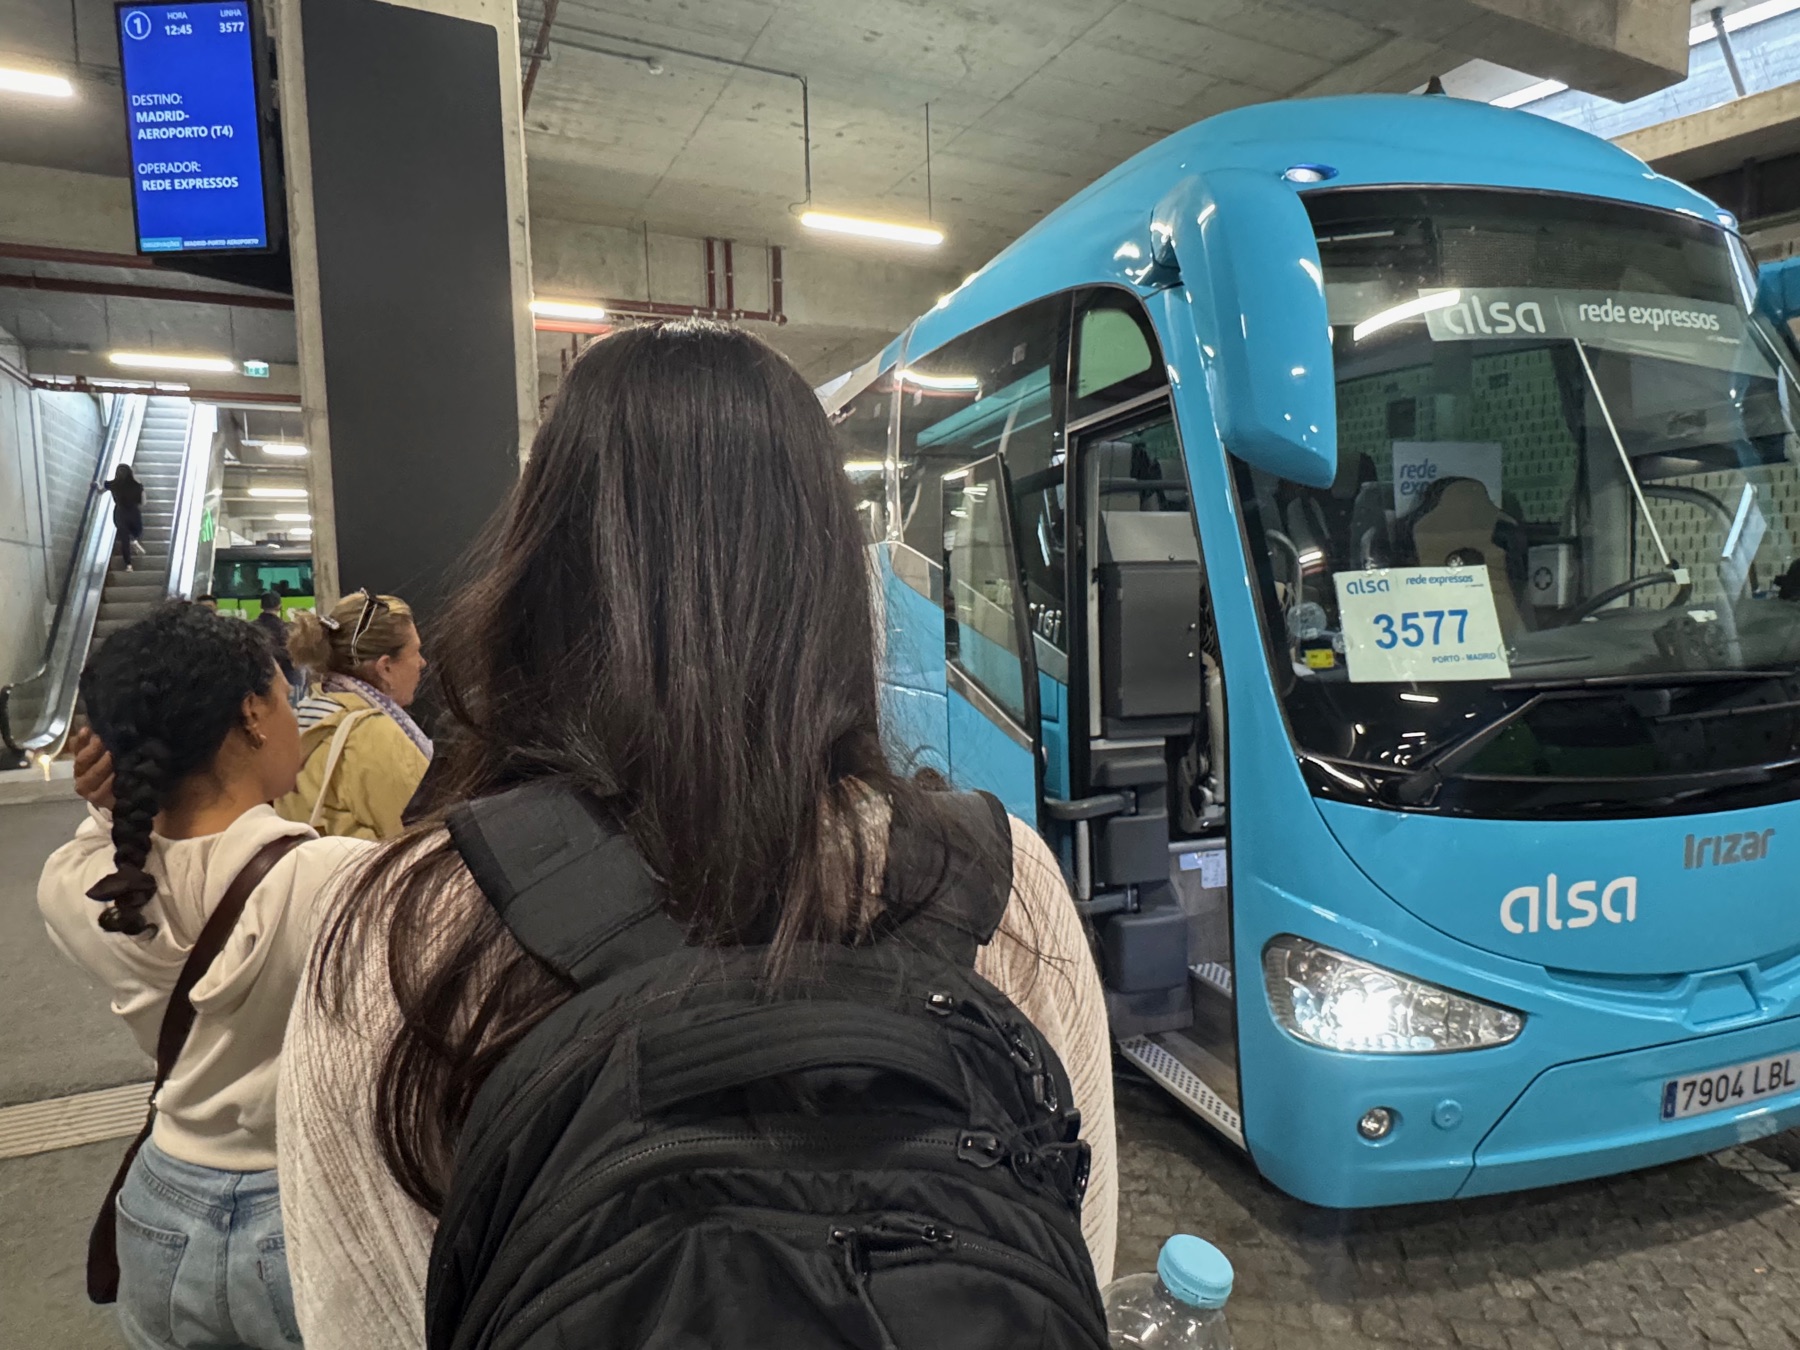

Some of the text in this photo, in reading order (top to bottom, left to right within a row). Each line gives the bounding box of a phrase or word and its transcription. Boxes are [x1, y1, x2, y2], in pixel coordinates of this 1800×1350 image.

[167, 11, 188, 20] HORA
[220, 9, 242, 18] LINHA
[164, 24, 193, 36] 12:45
[219, 21, 245, 33] 3577
[132, 93, 183, 107] DESTINO:
[136, 110, 190, 123] MADRID-
[137, 124, 234, 140] AEROPORTO (T4)
[137, 161, 202, 175] OPERADOR:
[142, 176, 239, 191] REDE EXPRESSOS
[1443, 295, 1720, 335] alsa rede expressos
[1400, 458, 1437, 479] rede
[1346, 578, 1390, 595] alsa
[1406, 574, 1427, 586] rede
[1428, 574, 1474, 586] expressos
[1373, 609, 1469, 650] 3577
[1432, 654, 1461, 664] PORTO
[1466, 652, 1496, 661] MADRID
[1500, 873, 1637, 934] alsa
[1682, 1058, 1796, 1111] 7904 LBL
